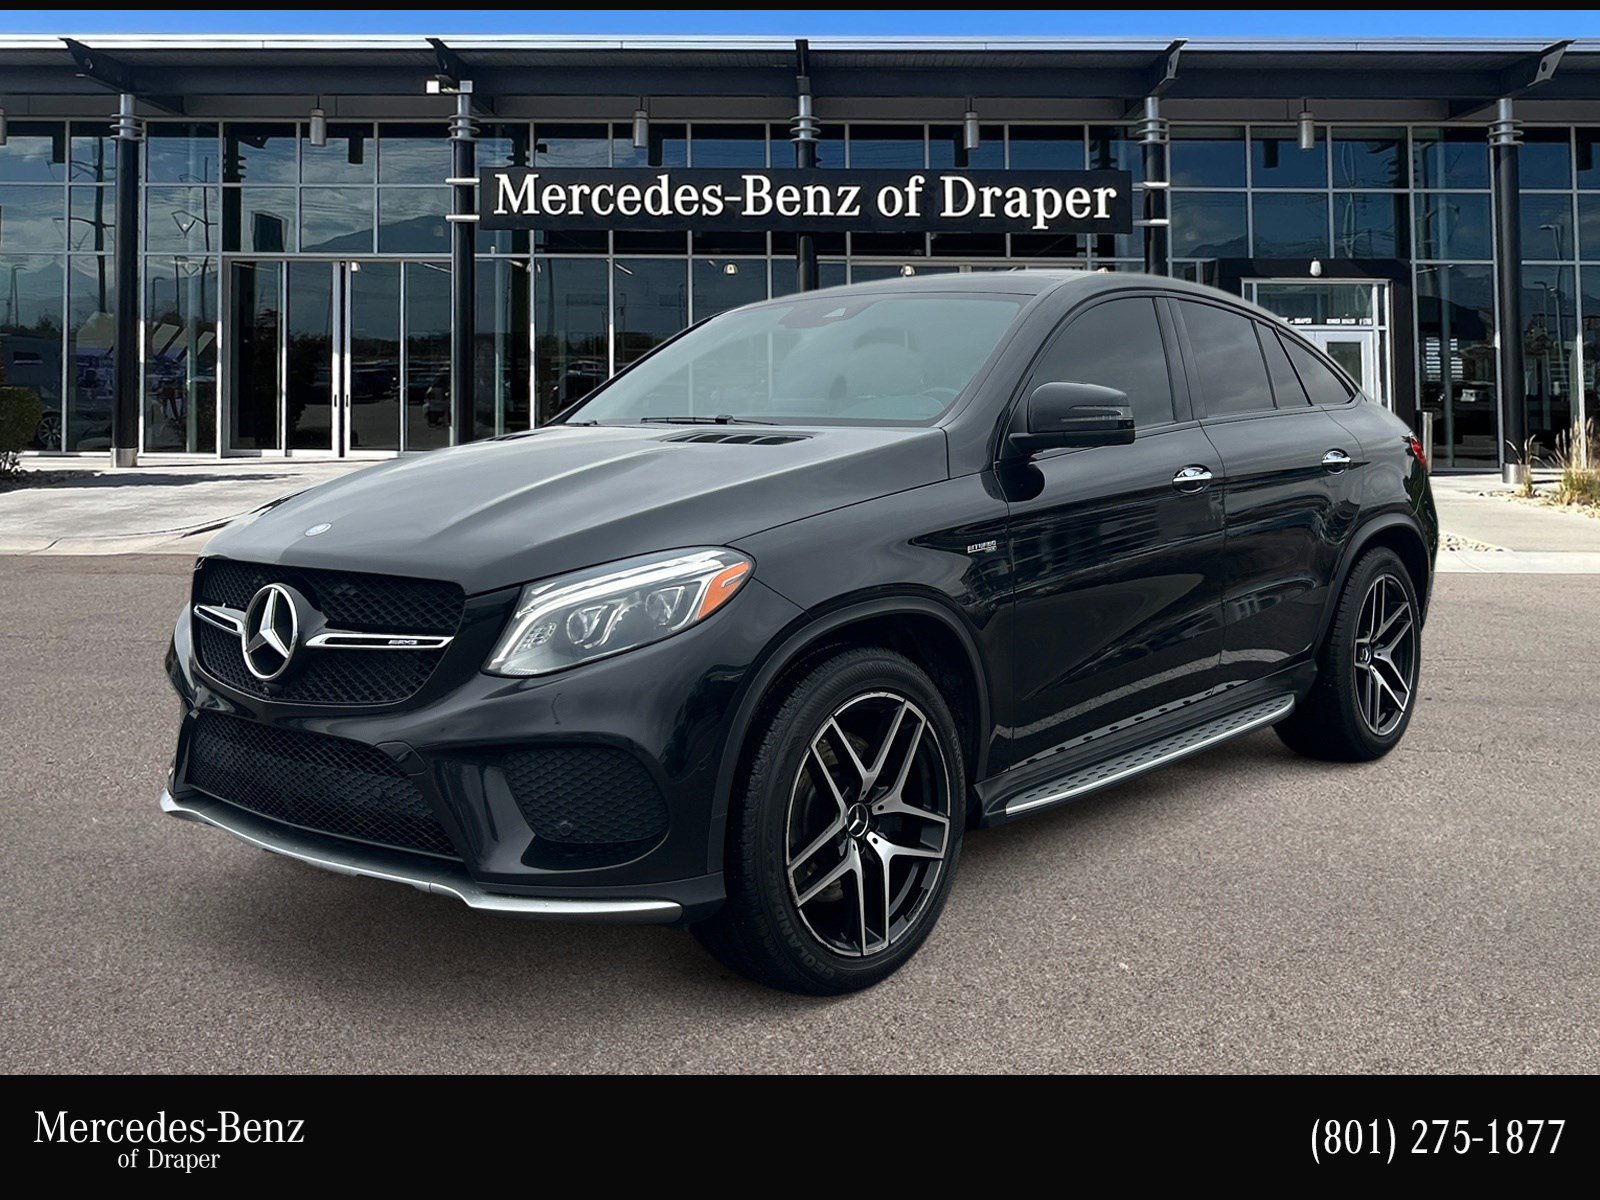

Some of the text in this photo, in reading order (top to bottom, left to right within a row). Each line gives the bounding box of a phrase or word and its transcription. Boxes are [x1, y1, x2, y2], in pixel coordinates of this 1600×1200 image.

[493, 173, 1117, 230] Mercedes-Benz of Draper
